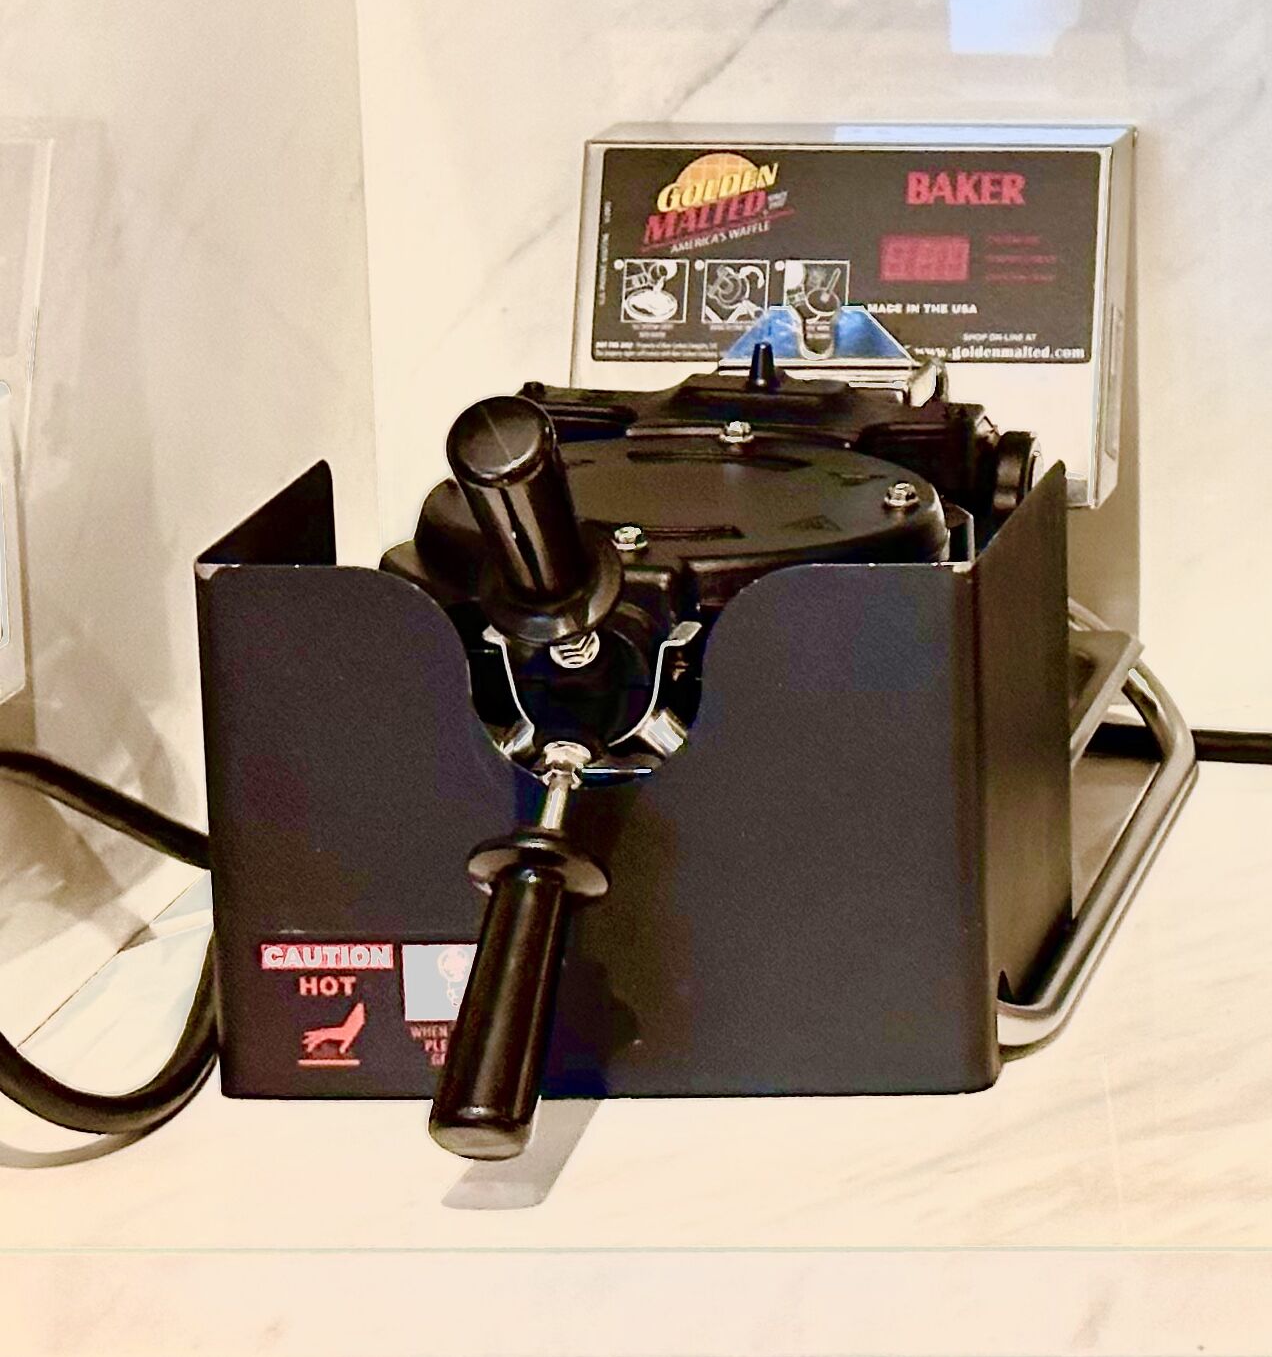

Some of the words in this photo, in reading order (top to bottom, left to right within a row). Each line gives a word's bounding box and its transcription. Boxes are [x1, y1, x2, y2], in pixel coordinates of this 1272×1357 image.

[656, 162, 779, 213] GOLDEN
[906, 170, 1026, 205] BAKER
[644, 189, 768, 244] MALTED
[728, 221, 770, 240] WAFFLE
[867, 303, 902, 314] MADE
[906, 303, 920, 314] IN
[923, 303, 948, 314] THE
[951, 303, 978, 314] USA
[962, 333, 985, 342] SHOP
[1025, 333, 1037, 341] AT
[914, 344, 1086, 360] www.goldenmalted.com
[264, 946, 391, 967] CAUTION
[299, 976, 357, 996] HOT
[410, 1025, 448, 1040] WHEN
